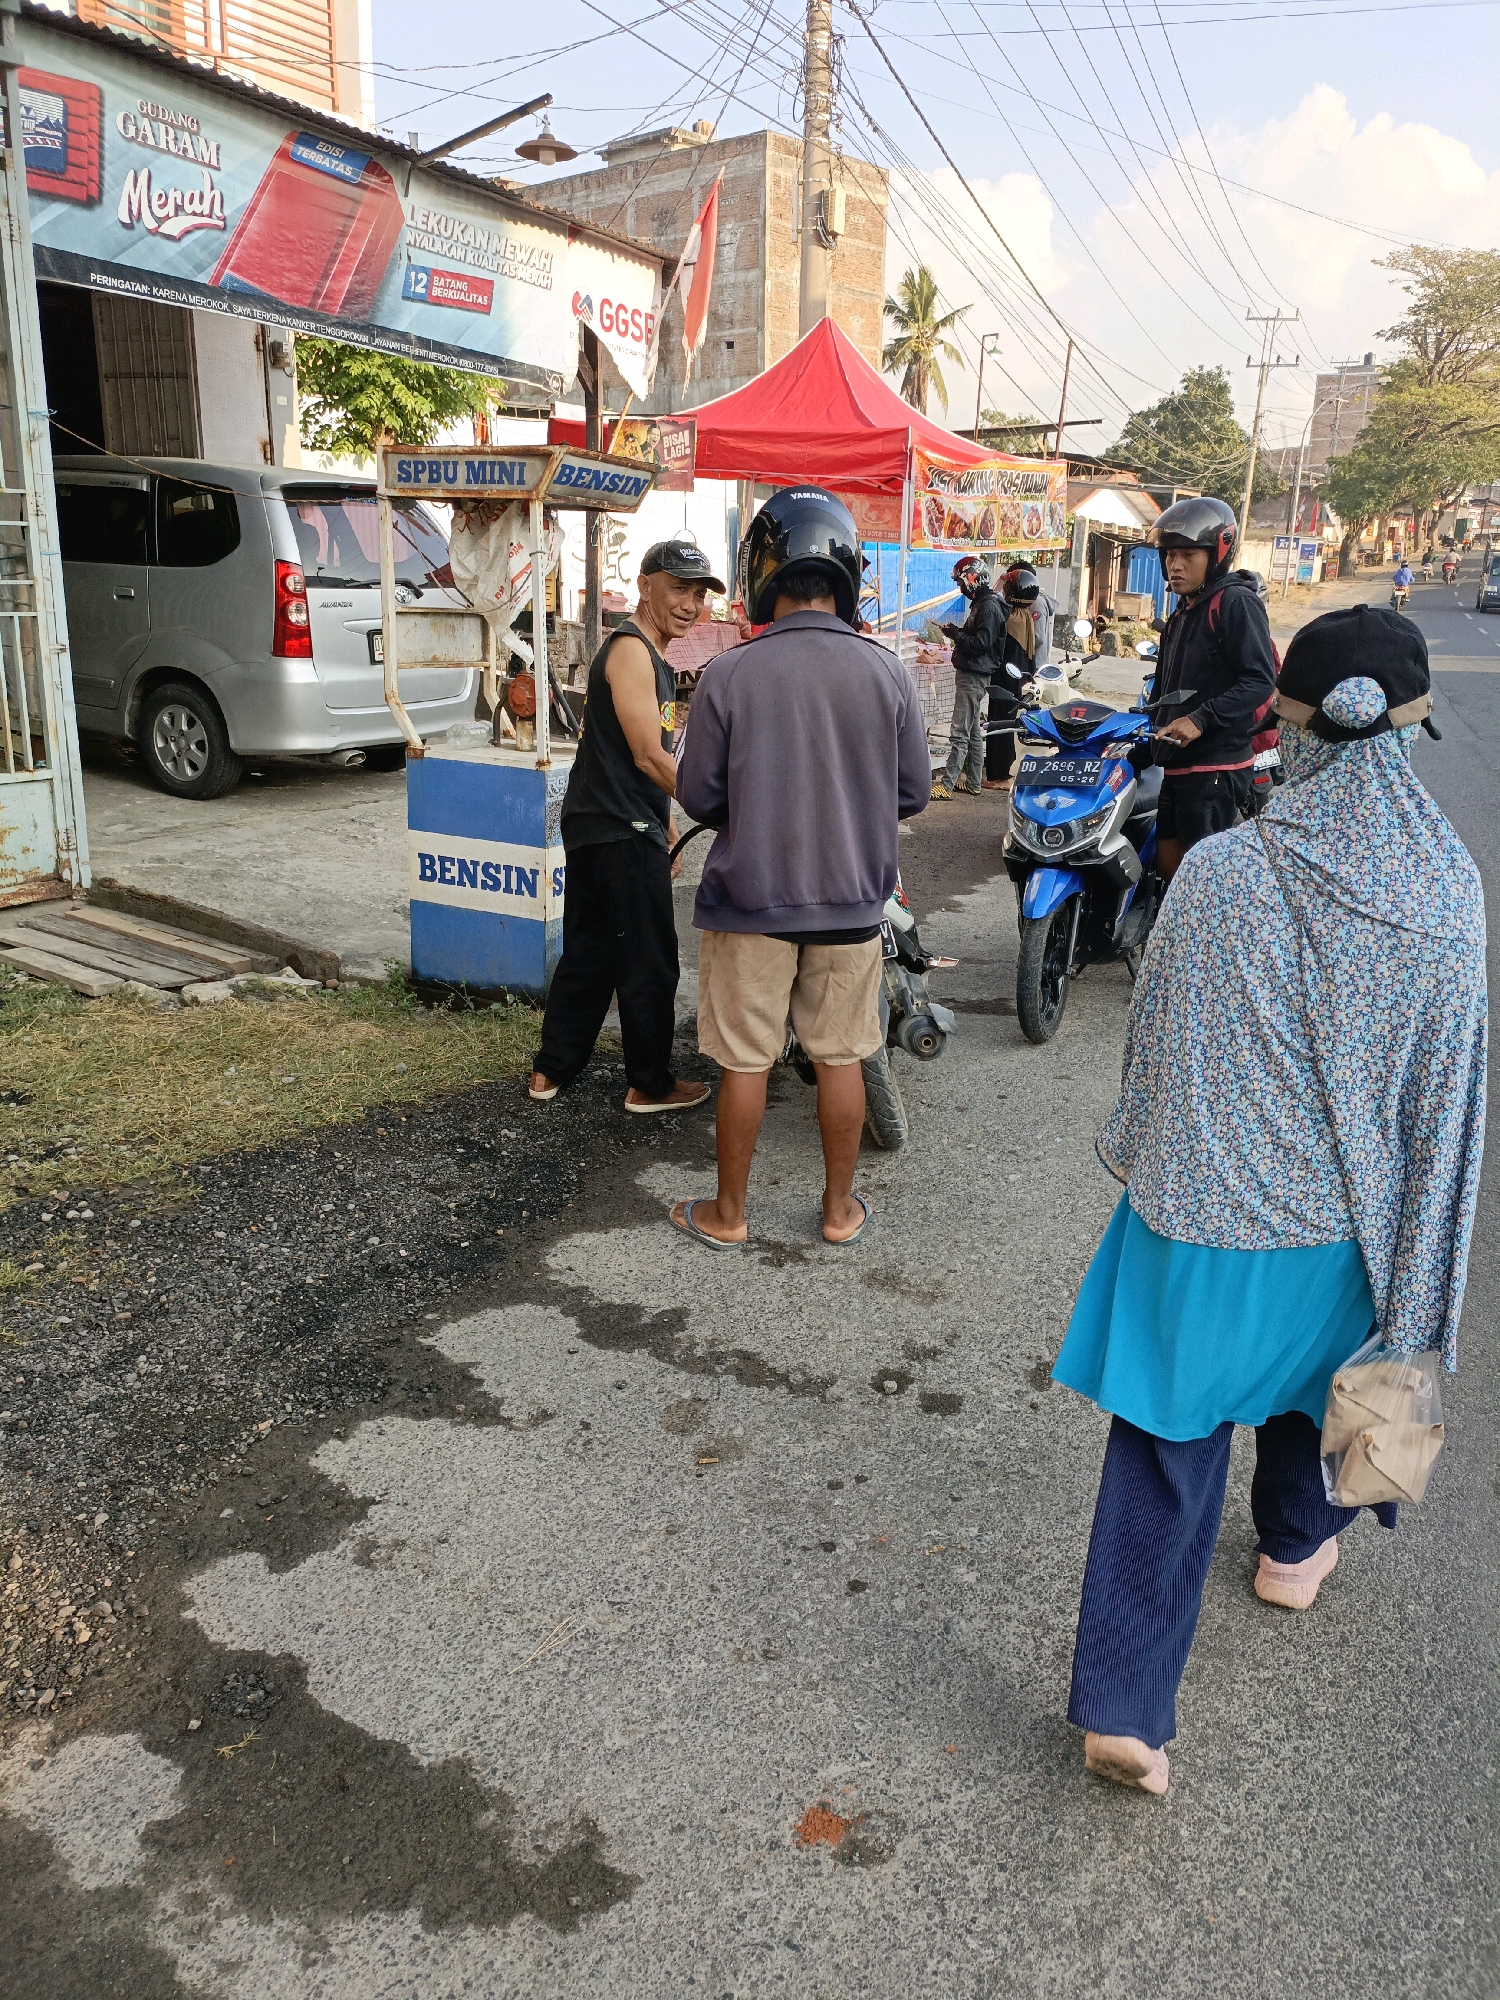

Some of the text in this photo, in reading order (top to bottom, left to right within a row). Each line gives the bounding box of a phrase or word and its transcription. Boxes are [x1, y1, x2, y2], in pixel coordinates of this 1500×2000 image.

[136, 98, 198, 132] GUDANG
[115, 111, 221, 170] GARAM
[315, 141, 346, 159] EDISI
[296, 146, 353, 176] TERBATAS
[117, 167, 226, 238] Merah
[405, 203, 554, 274] LEKUKAN MEWAH
[405, 229, 553, 291] NYALAKAN KUALITAS MERAH
[409, 270, 428, 294] 12
[431, 286, 489, 306] BERKUALITAS
[433, 275, 469, 292] BATANG
[90, 272, 151, 295] PERINGATAN:
[152, 286, 189, 304] KARENA
[232, 304, 252, 316] SAYA
[252, 308, 287, 324] TERKENA
[287, 317, 316, 331] KANKER
[370, 336, 401, 350] LAYANAN
[662, 433, 686, 449] BISA
[397, 459, 526, 486] SPBU MINI
[553, 463, 649, 497] BENSIN
[790, 492, 830, 503] YAMAHA
[1020, 761, 1037, 773] DD
[1083, 761, 1101, 773] RZ
[417, 852, 540, 899] BENSIN
